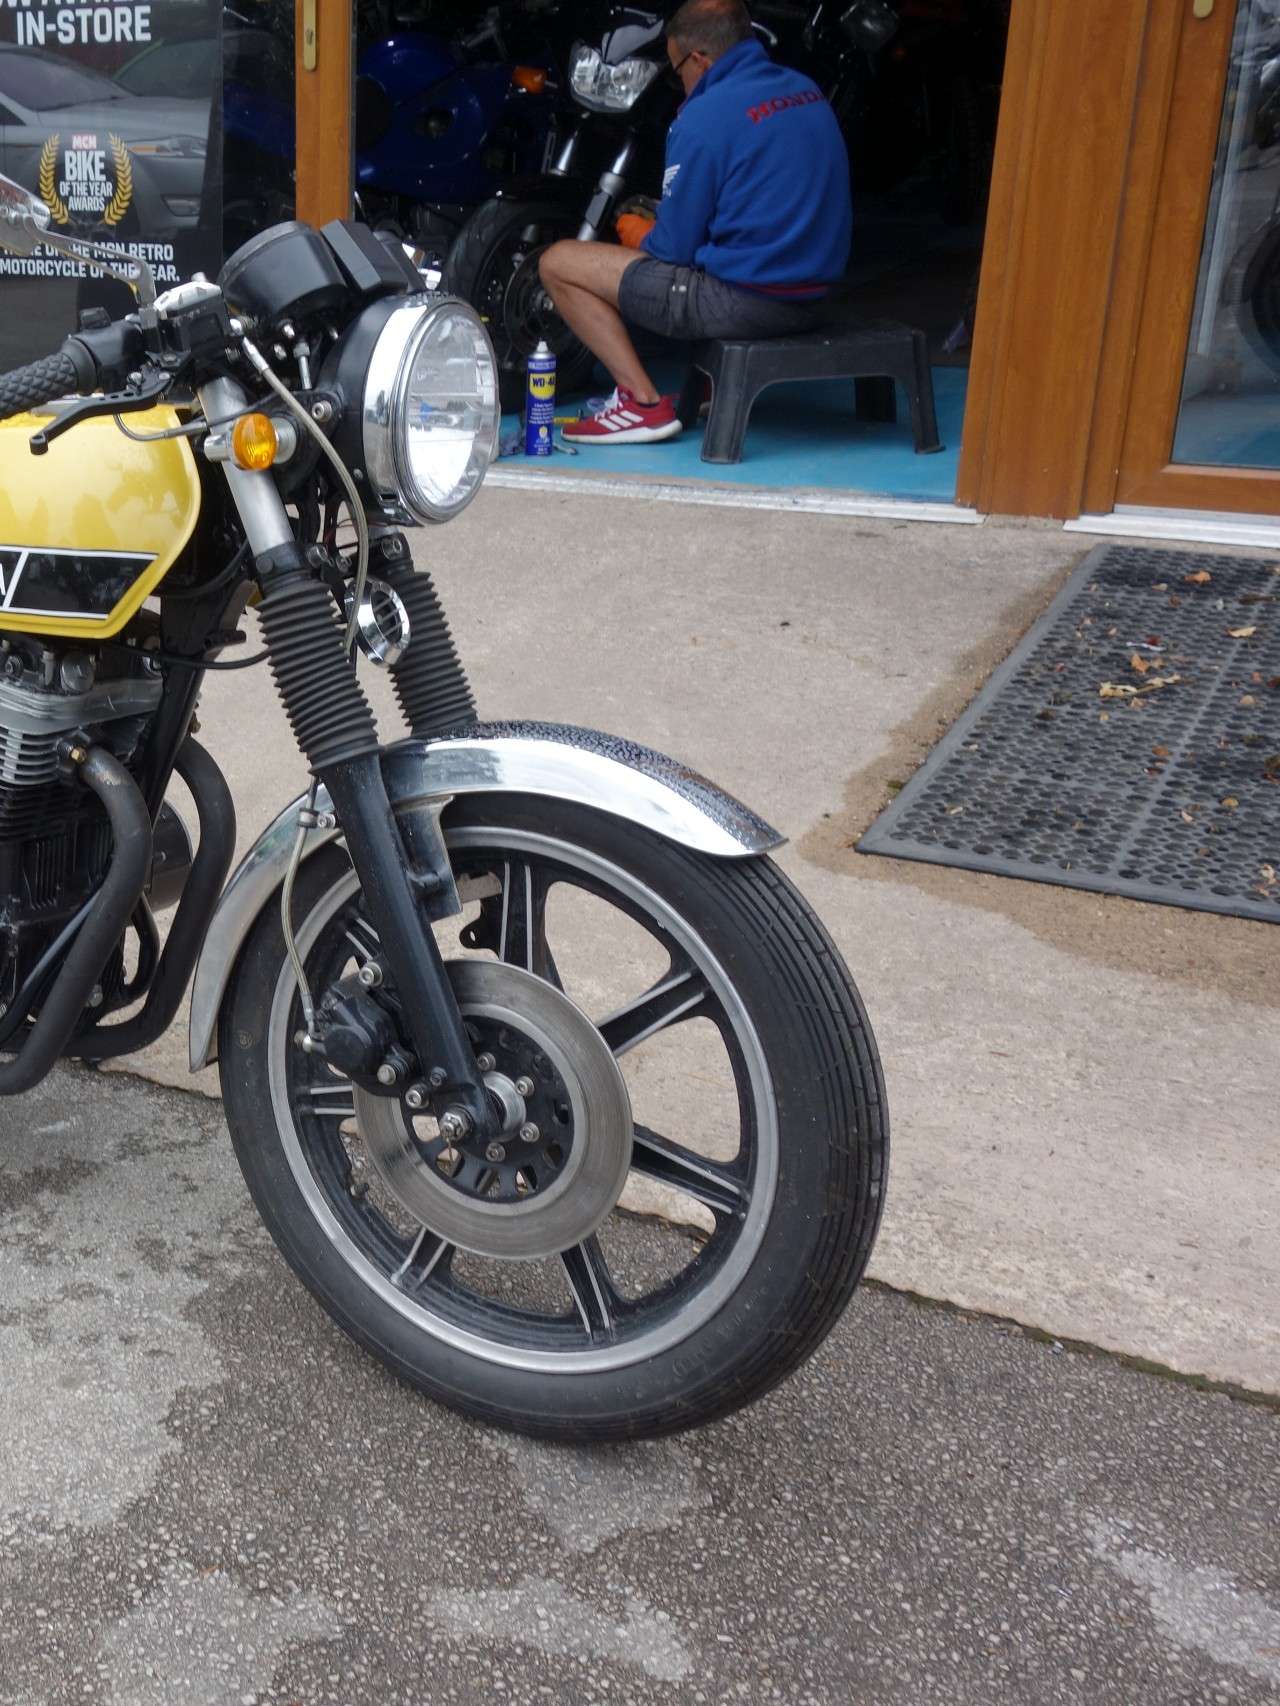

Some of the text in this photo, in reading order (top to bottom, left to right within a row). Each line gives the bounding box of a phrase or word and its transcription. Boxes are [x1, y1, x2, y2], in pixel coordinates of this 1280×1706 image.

[16, 5, 151, 46] IN-STORE
[745, 90, 824, 125] HOND
[72, 135, 97, 150] MCN
[64, 150, 106, 182] BIKE
[60, 182, 113, 197] OF THE YEAR
[68, 196, 106, 211] AWARDS
[69, 243, 90, 258] HE
[129, 243, 174, 262] RETRO
[0, 258, 87, 278] MOTORCYCLE
[151, 264, 181, 282] EAR.
